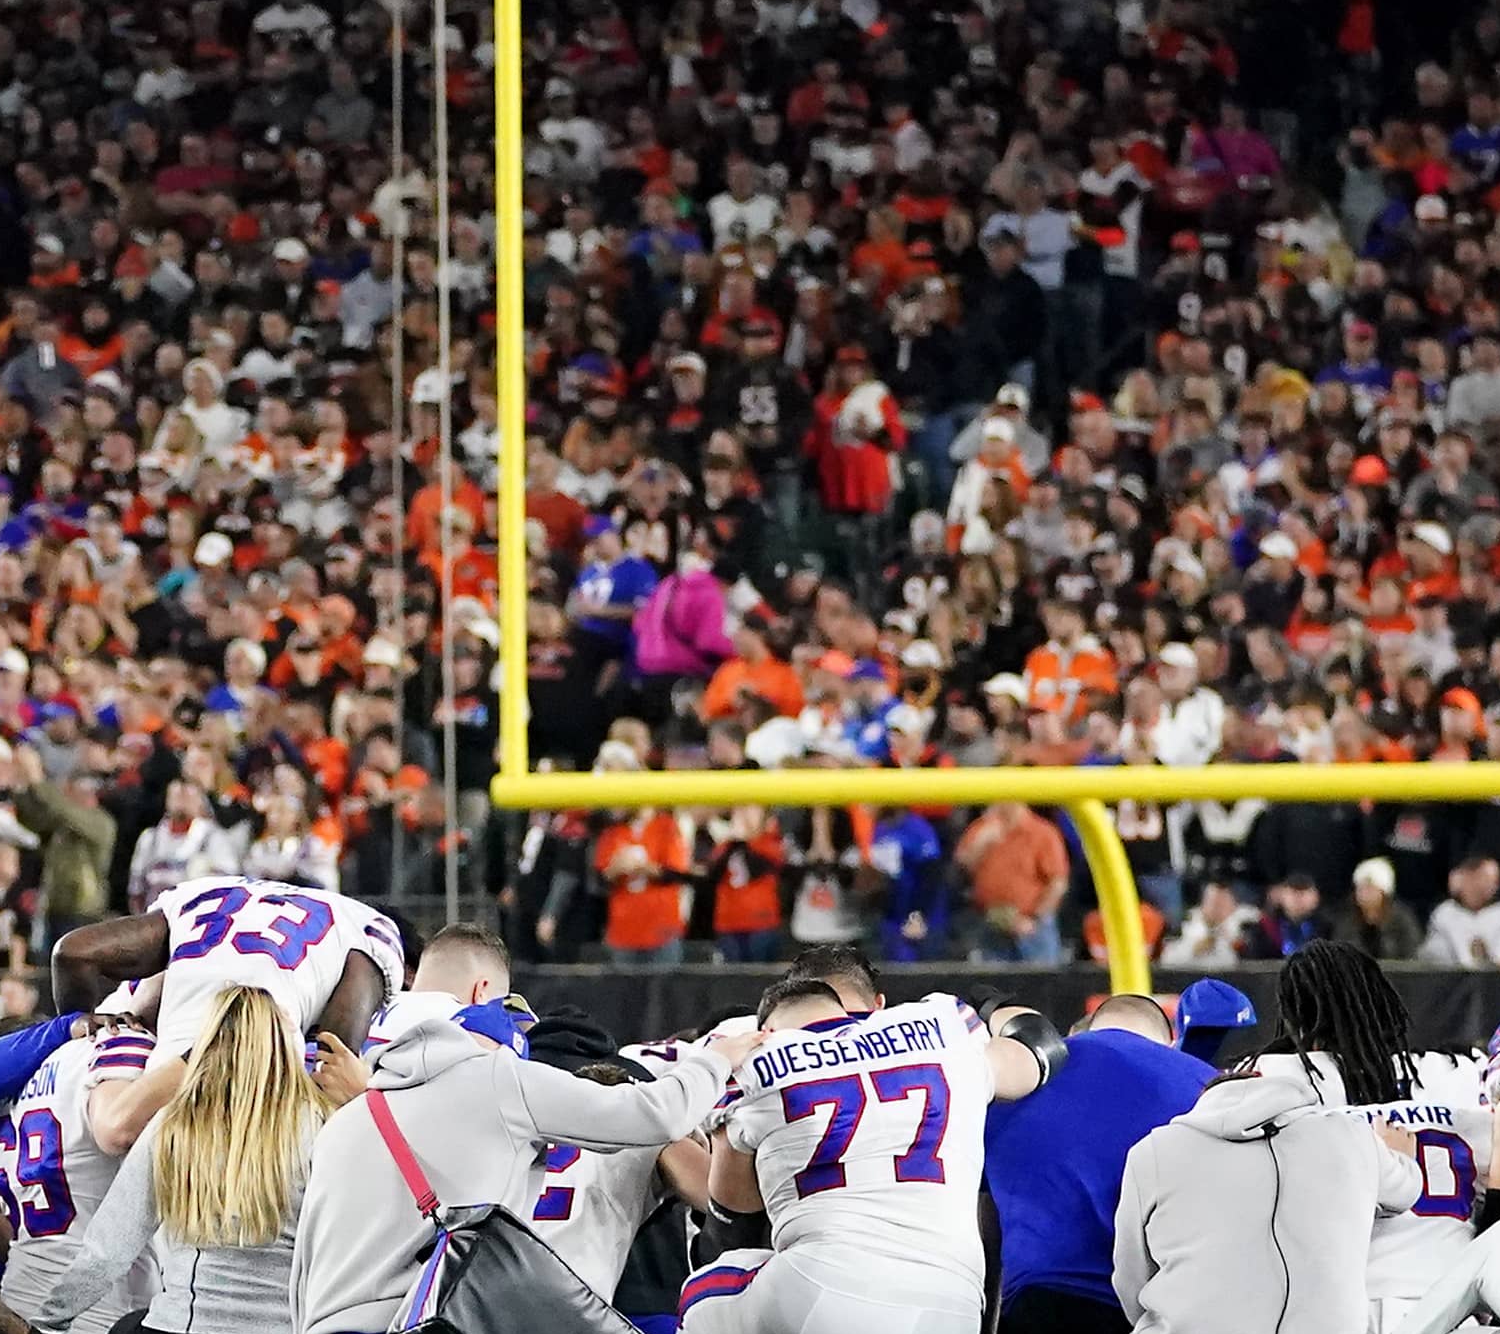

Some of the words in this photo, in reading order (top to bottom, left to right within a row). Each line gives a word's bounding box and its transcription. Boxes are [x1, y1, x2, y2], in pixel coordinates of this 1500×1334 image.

[168, 885, 336, 971] 33
[751, 1016, 947, 1089] QUESSENBERRY
[780, 1062, 952, 1200] 77
